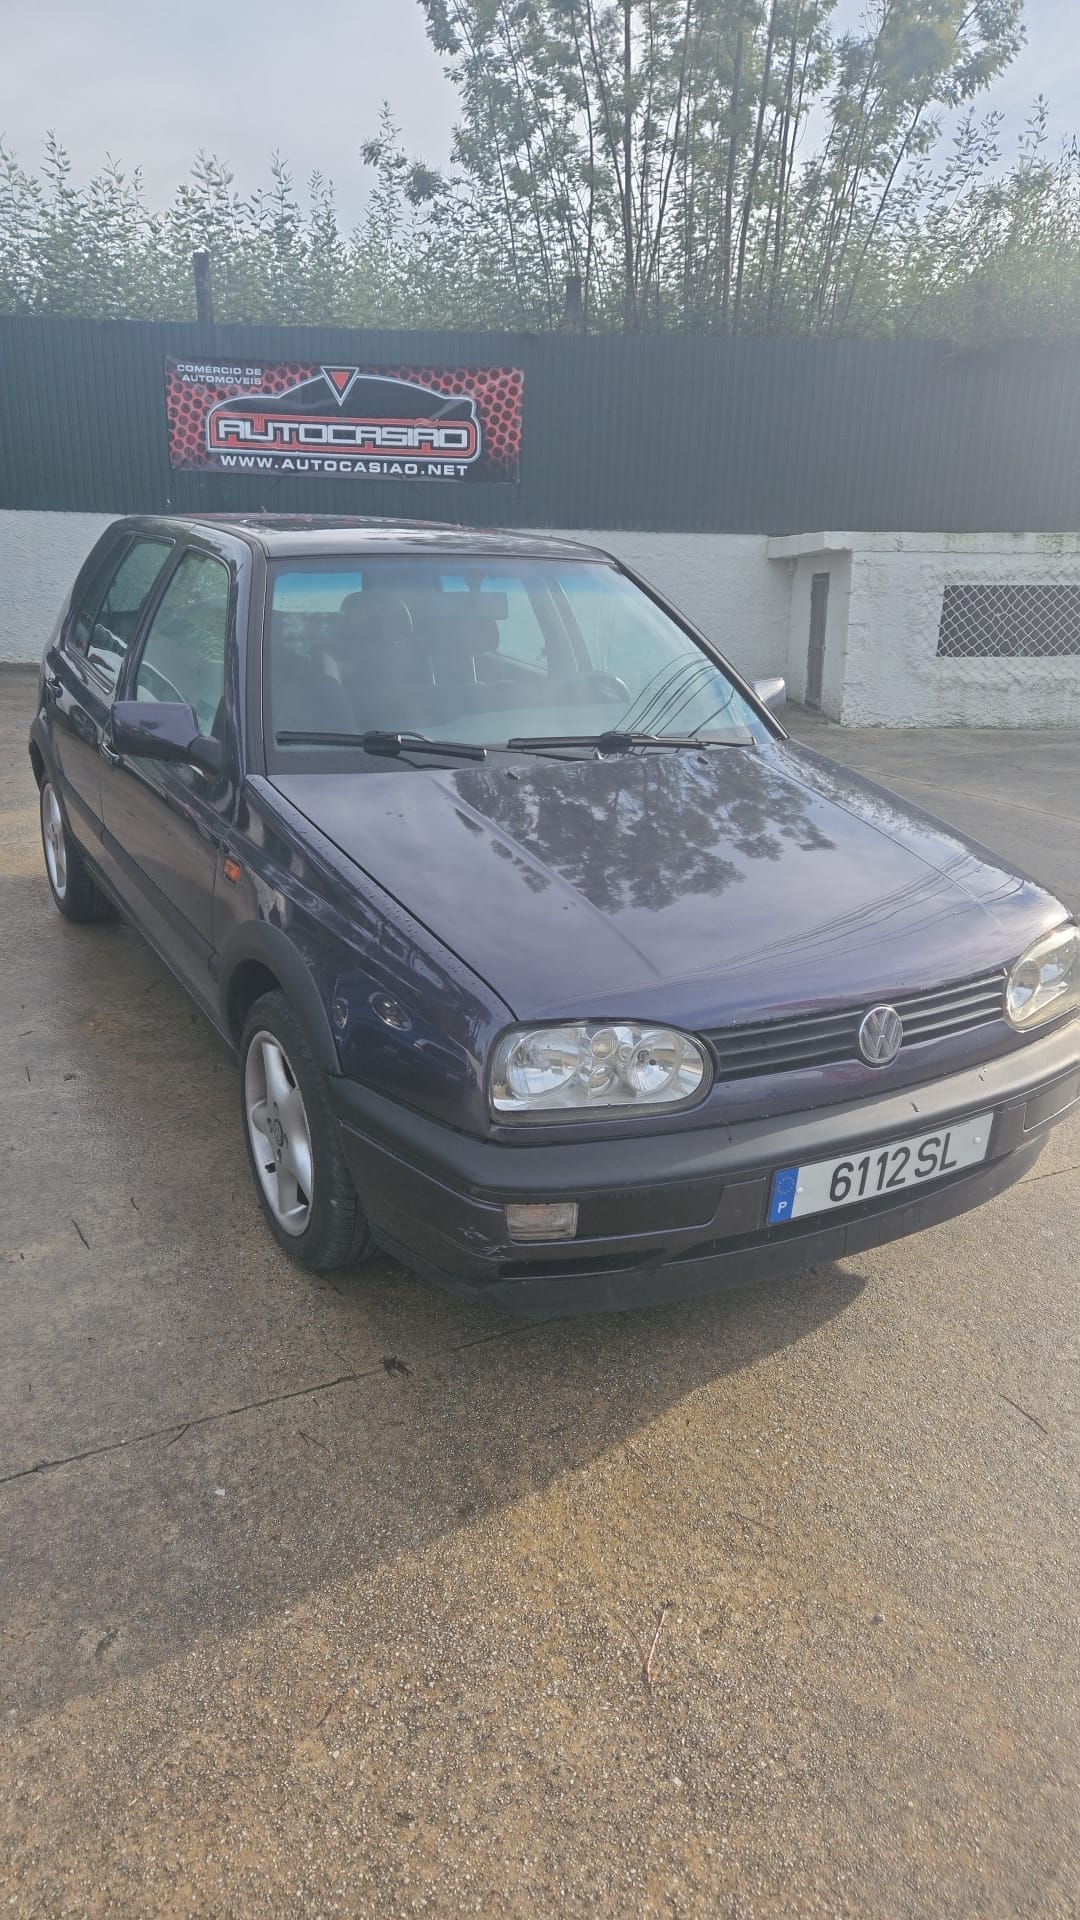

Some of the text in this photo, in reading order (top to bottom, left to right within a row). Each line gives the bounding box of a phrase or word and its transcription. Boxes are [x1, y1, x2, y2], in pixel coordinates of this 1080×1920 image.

[246, 367, 262, 376] DE
[220, 455, 468, 476] WWW.AUTOCASIAO.NET
[777, 1202, 788, 1214] P
